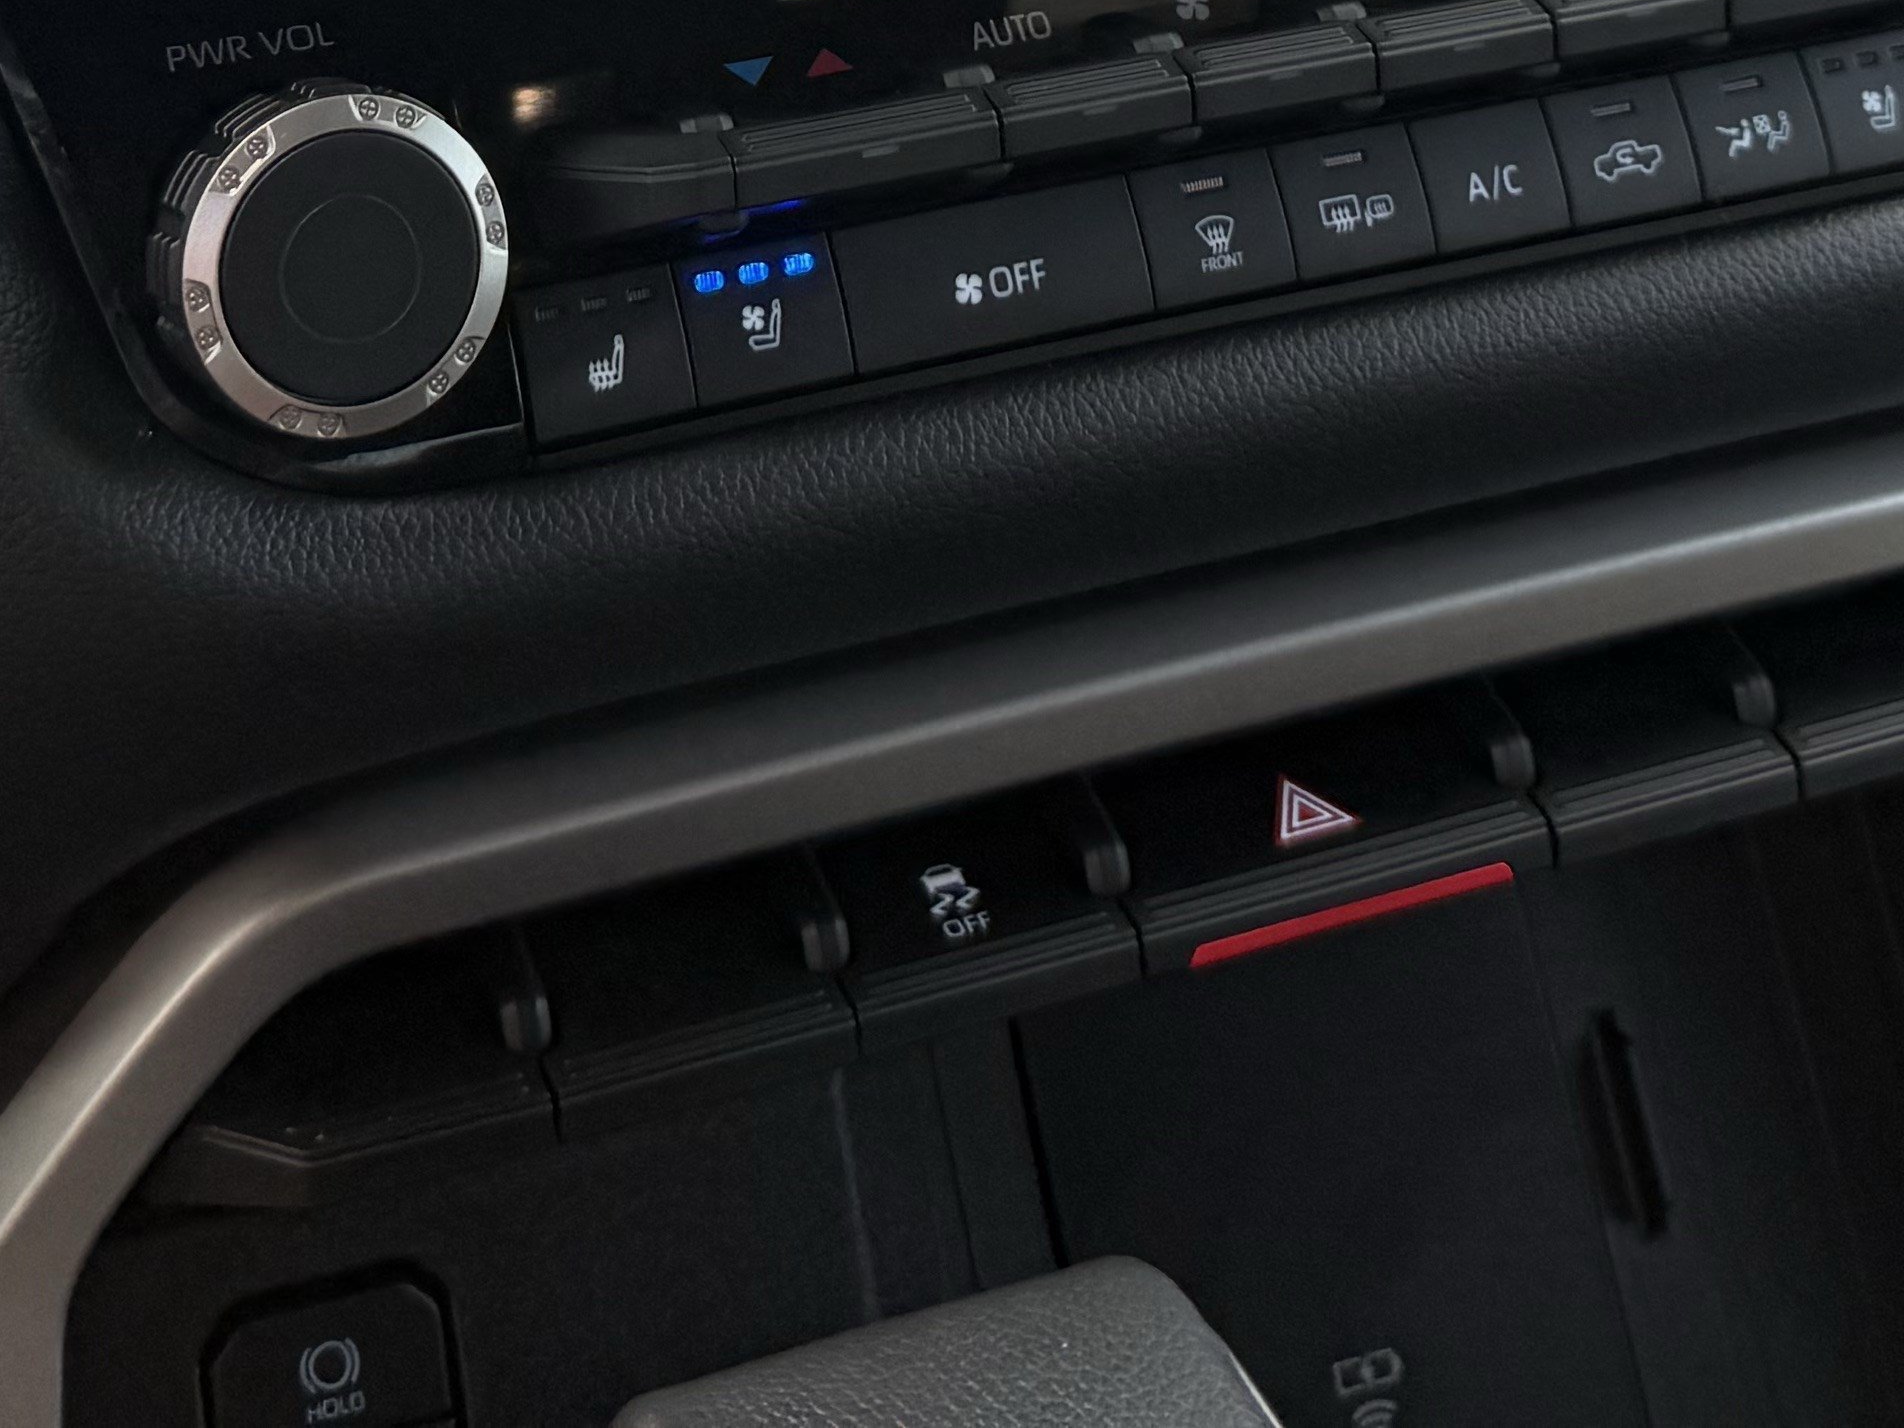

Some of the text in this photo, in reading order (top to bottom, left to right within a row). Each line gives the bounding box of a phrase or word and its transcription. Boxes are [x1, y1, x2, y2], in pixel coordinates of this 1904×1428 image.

[167, 21, 335, 73] PWR VOL
[972, 10, 1051, 51] AUTO
[1468, 164, 1523, 203] A/C
[988, 258, 1047, 299] OFF
[1201, 251, 1244, 273] FRONT
[942, 911, 992, 939] OFF
[306, 1390, 366, 1424] HOLD
